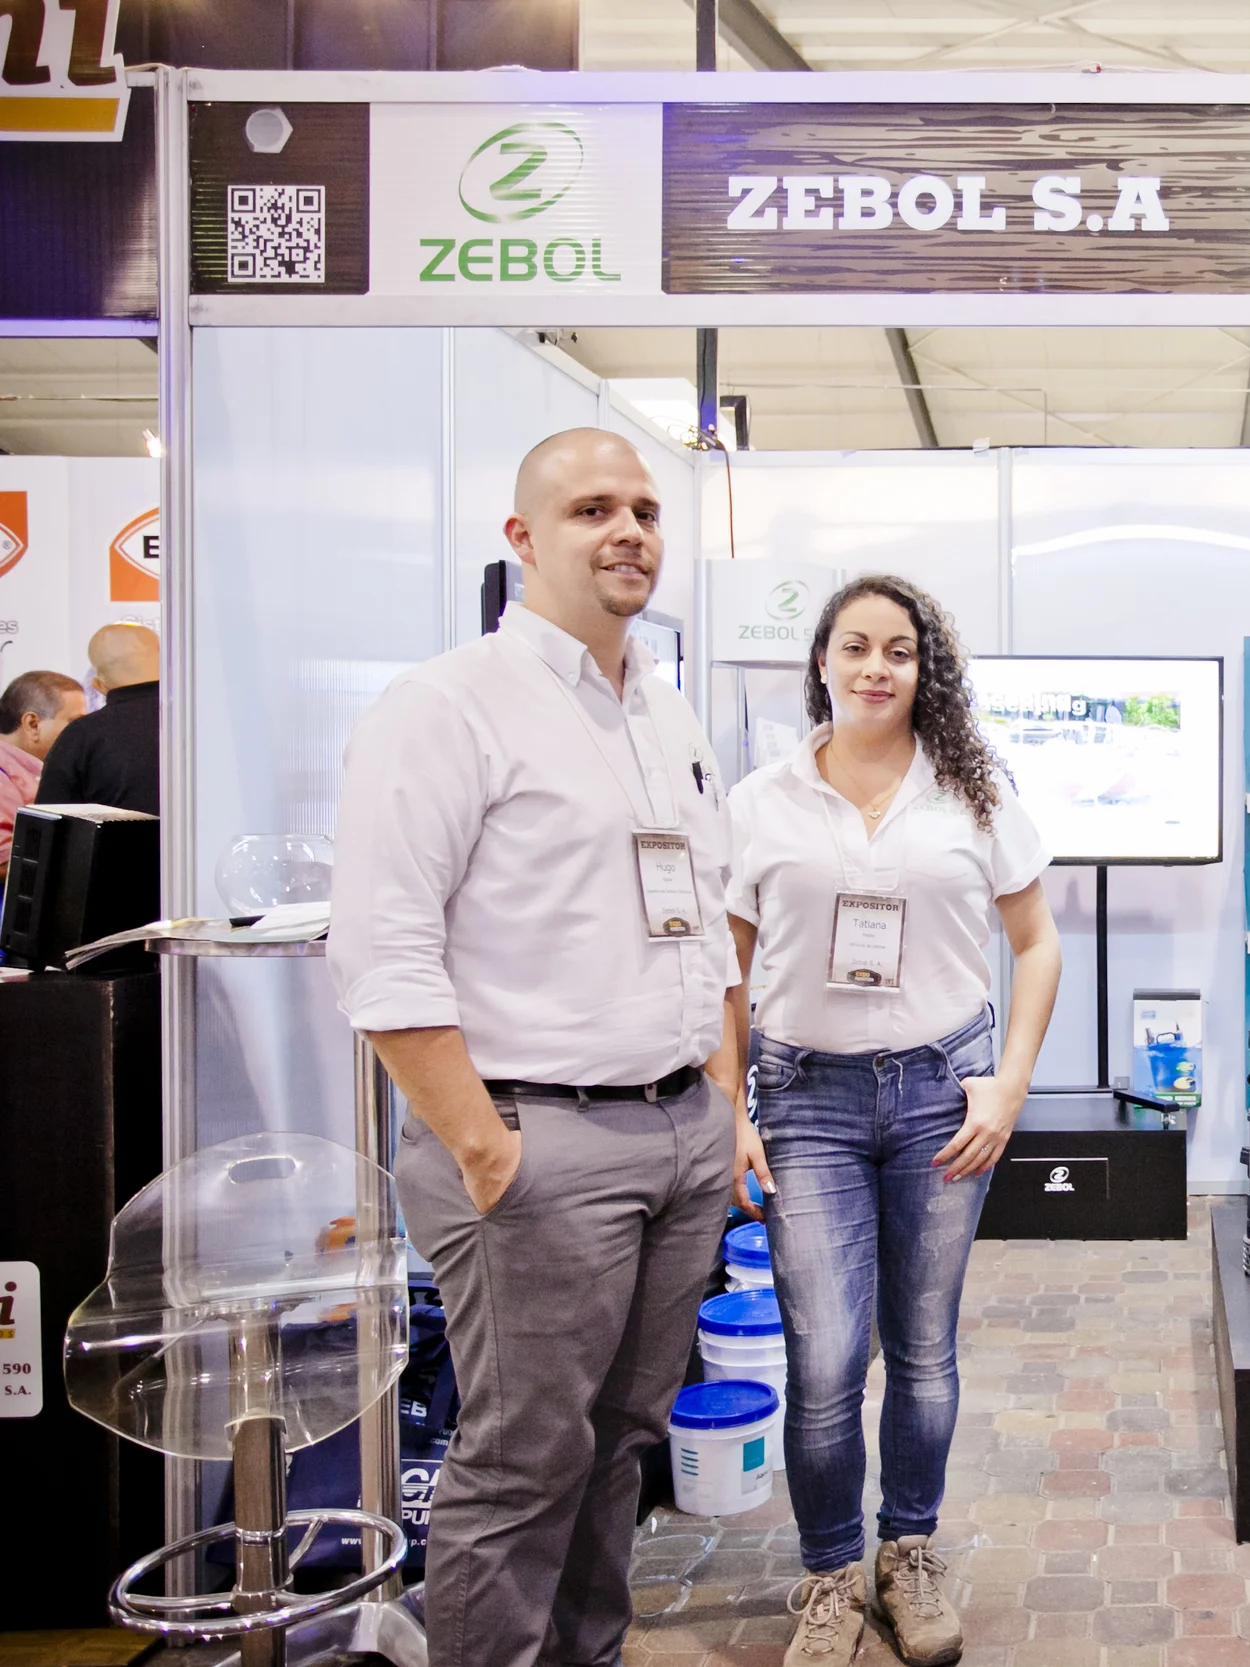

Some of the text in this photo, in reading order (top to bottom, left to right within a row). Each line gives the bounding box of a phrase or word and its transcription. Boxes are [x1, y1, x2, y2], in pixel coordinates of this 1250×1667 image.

[726, 175, 1170, 232] ZEBOL S.A
[418, 238, 622, 283] ZEBOL
[738, 625, 800, 641] ZEBOL
[641, 840, 686, 851] EXPOSITOR
[656, 861, 677, 875] Hugo
[842, 899, 900, 912] EXPOSITOR
[853, 918, 888, 930] Tatiana
[1044, 1182, 1076, 1193] ZEBOL
[2, 1362, 32, 1375] 590
[4, 1385, 32, 1396] S.A.
